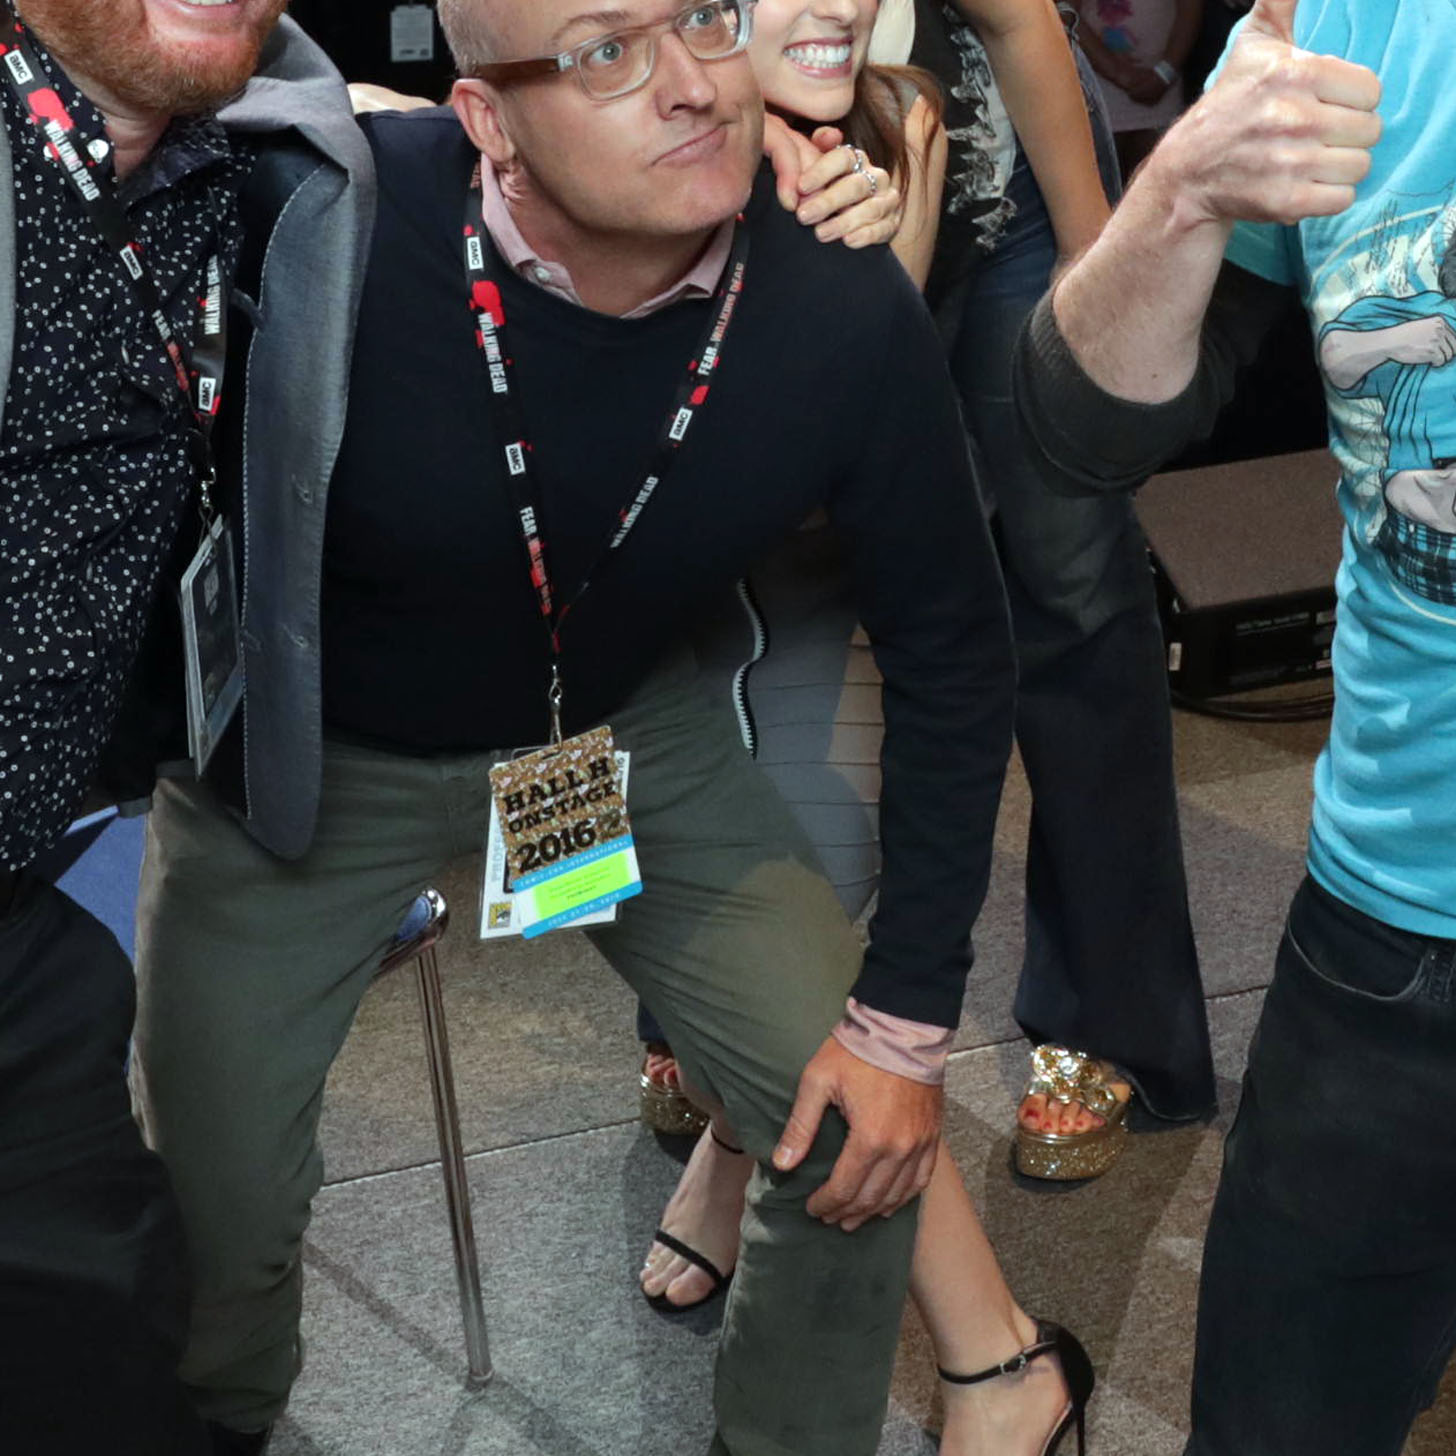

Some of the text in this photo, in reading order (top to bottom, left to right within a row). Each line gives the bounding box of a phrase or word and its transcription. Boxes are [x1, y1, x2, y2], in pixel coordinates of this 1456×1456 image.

[44, 119, 100, 201] WALKING DEAD
[151, 309, 172, 341] FEAR
[477, 311, 509, 395] WALKING DEAD
[697, 345, 718, 376] FEAR
[634, 475, 659, 505] DEAD
[519, 505, 538, 537] FEAR
[503, 770, 584, 815] HALL
[588, 757, 610, 779] H
[508, 780, 616, 833] ONSTAGE
[515, 820, 596, 874] 2016
